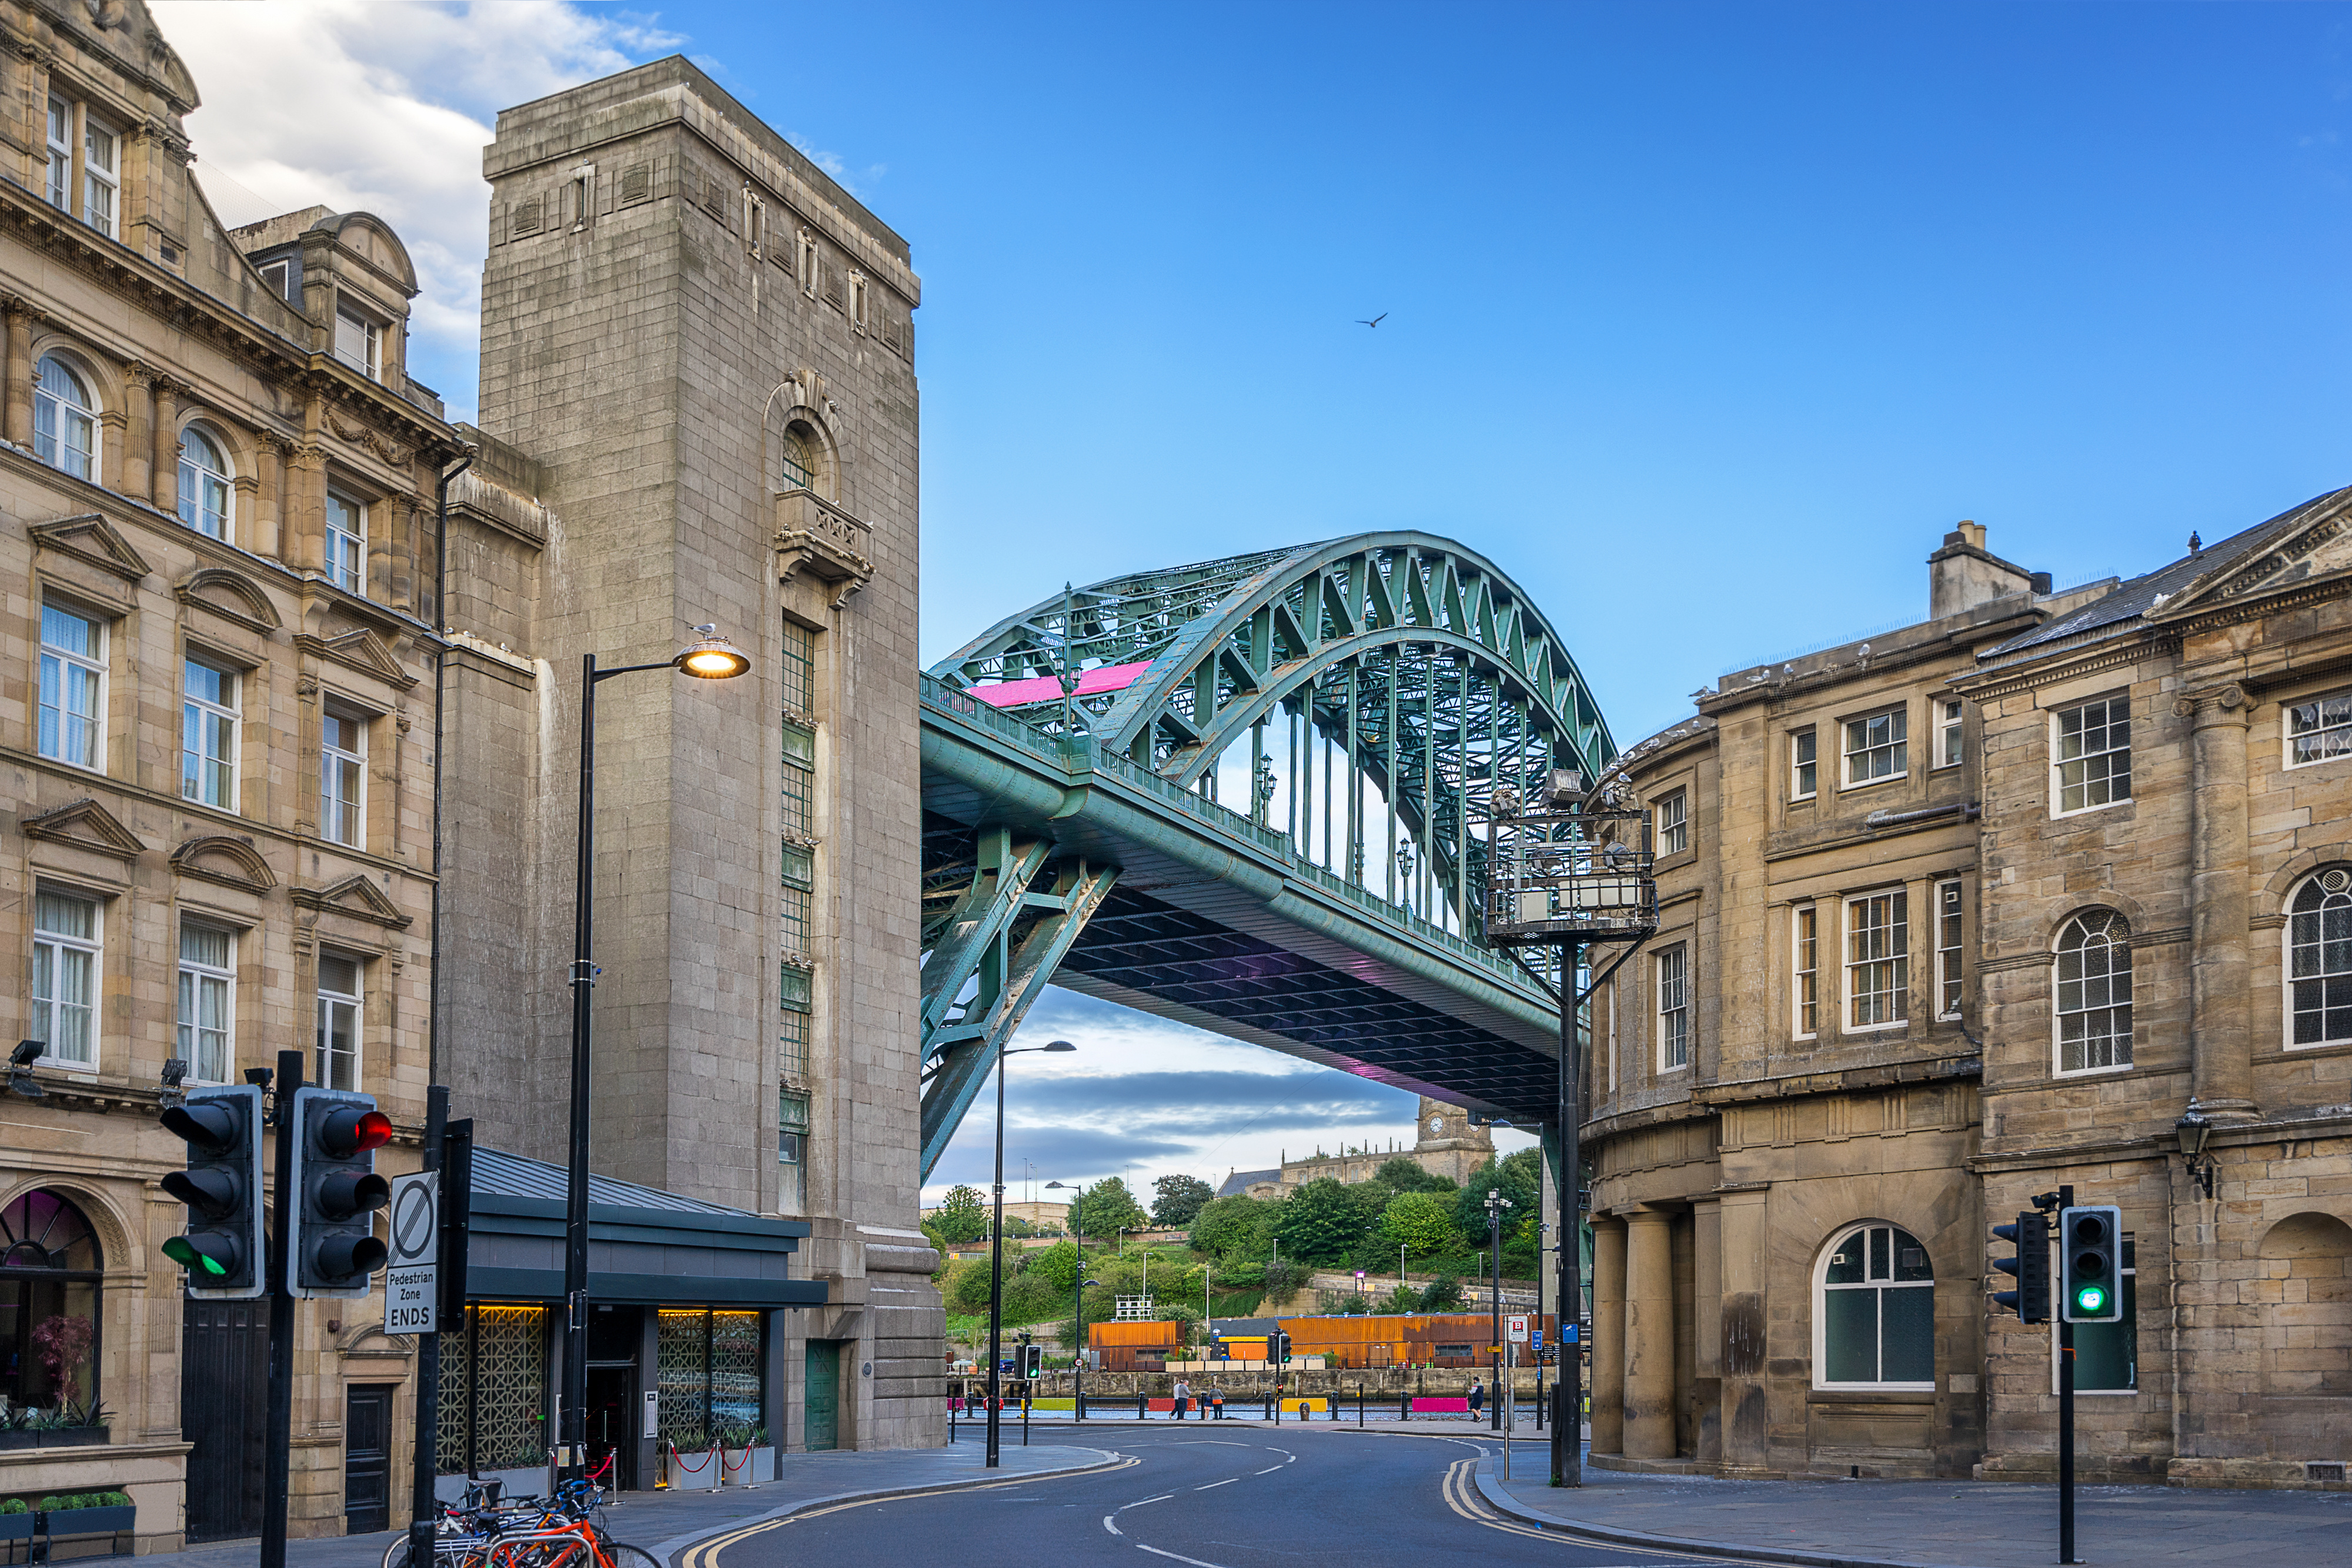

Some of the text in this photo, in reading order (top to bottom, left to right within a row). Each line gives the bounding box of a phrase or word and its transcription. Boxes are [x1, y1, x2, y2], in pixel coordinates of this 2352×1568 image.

[389, 1272, 433, 1286] Pedestrian
[400, 1288, 420, 1300] Zone
[391, 1306, 429, 1326] ENDS
